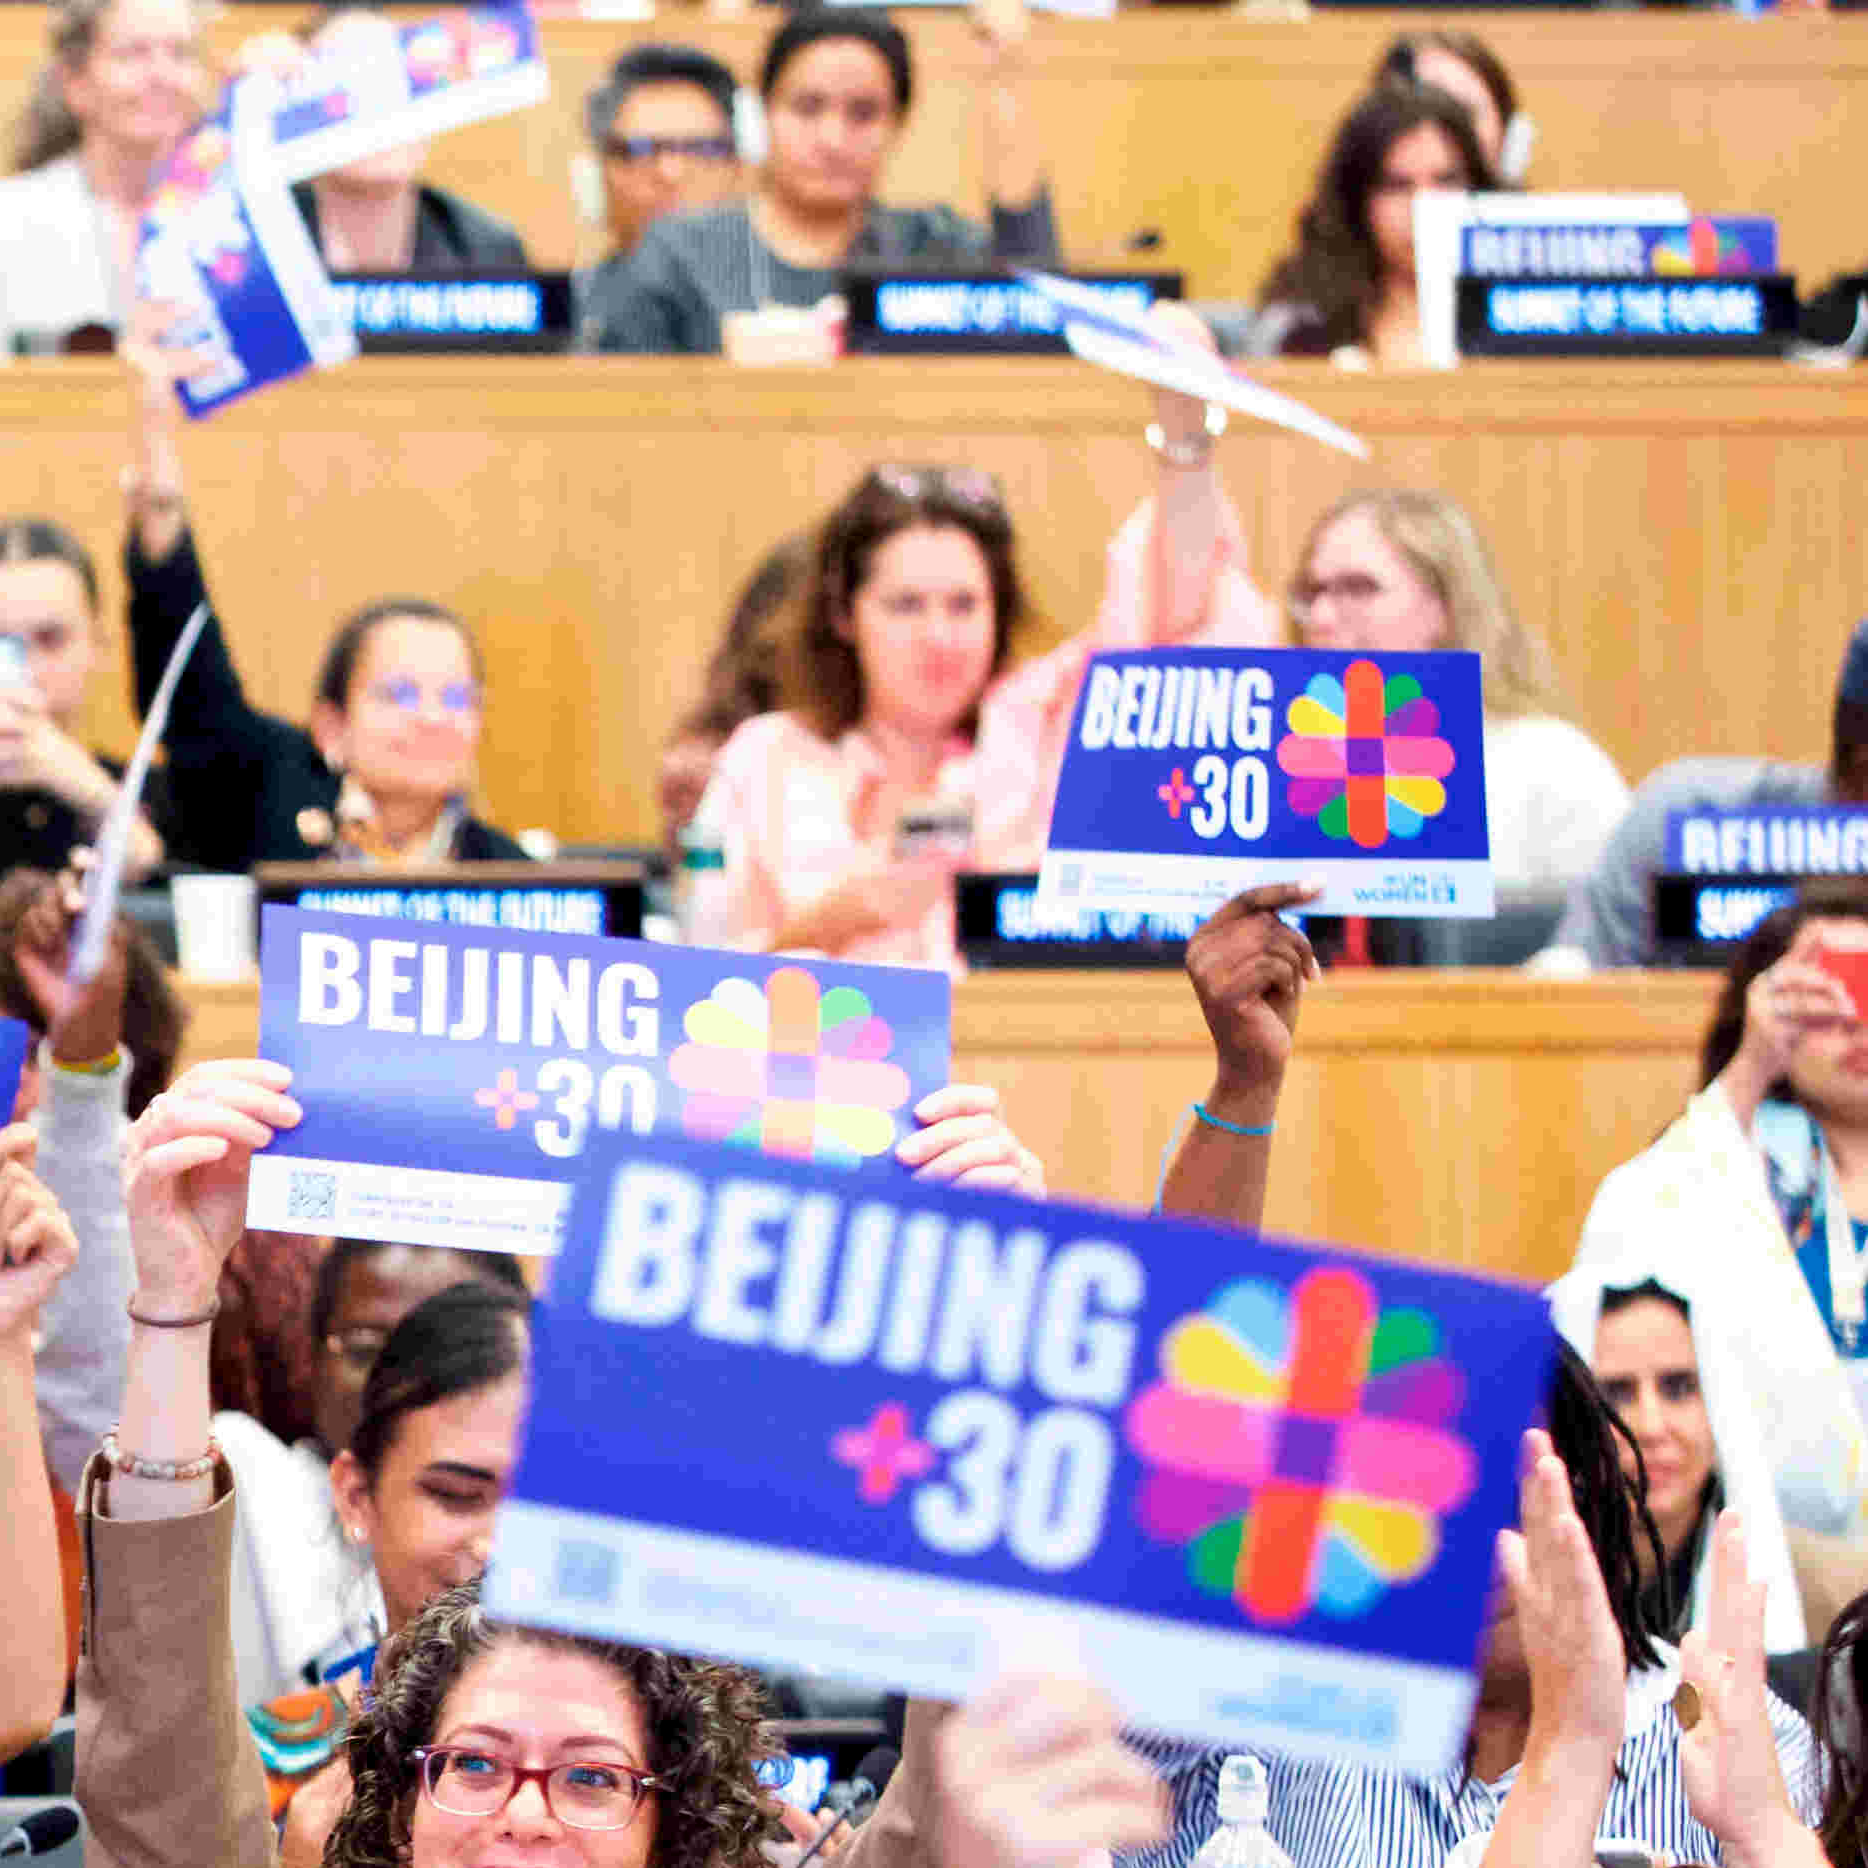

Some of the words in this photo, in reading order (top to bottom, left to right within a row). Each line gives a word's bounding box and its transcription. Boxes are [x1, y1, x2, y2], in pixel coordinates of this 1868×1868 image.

[1079, 664, 1275, 750] BEIJING
[1157, 755, 1270, 841] +30
[298, 930, 662, 1057] BEIJING
[475, 1058, 658, 1158] +30
[589, 1160, 1145, 1407] BEIJING
[832, 1389, 1117, 1572] +30
